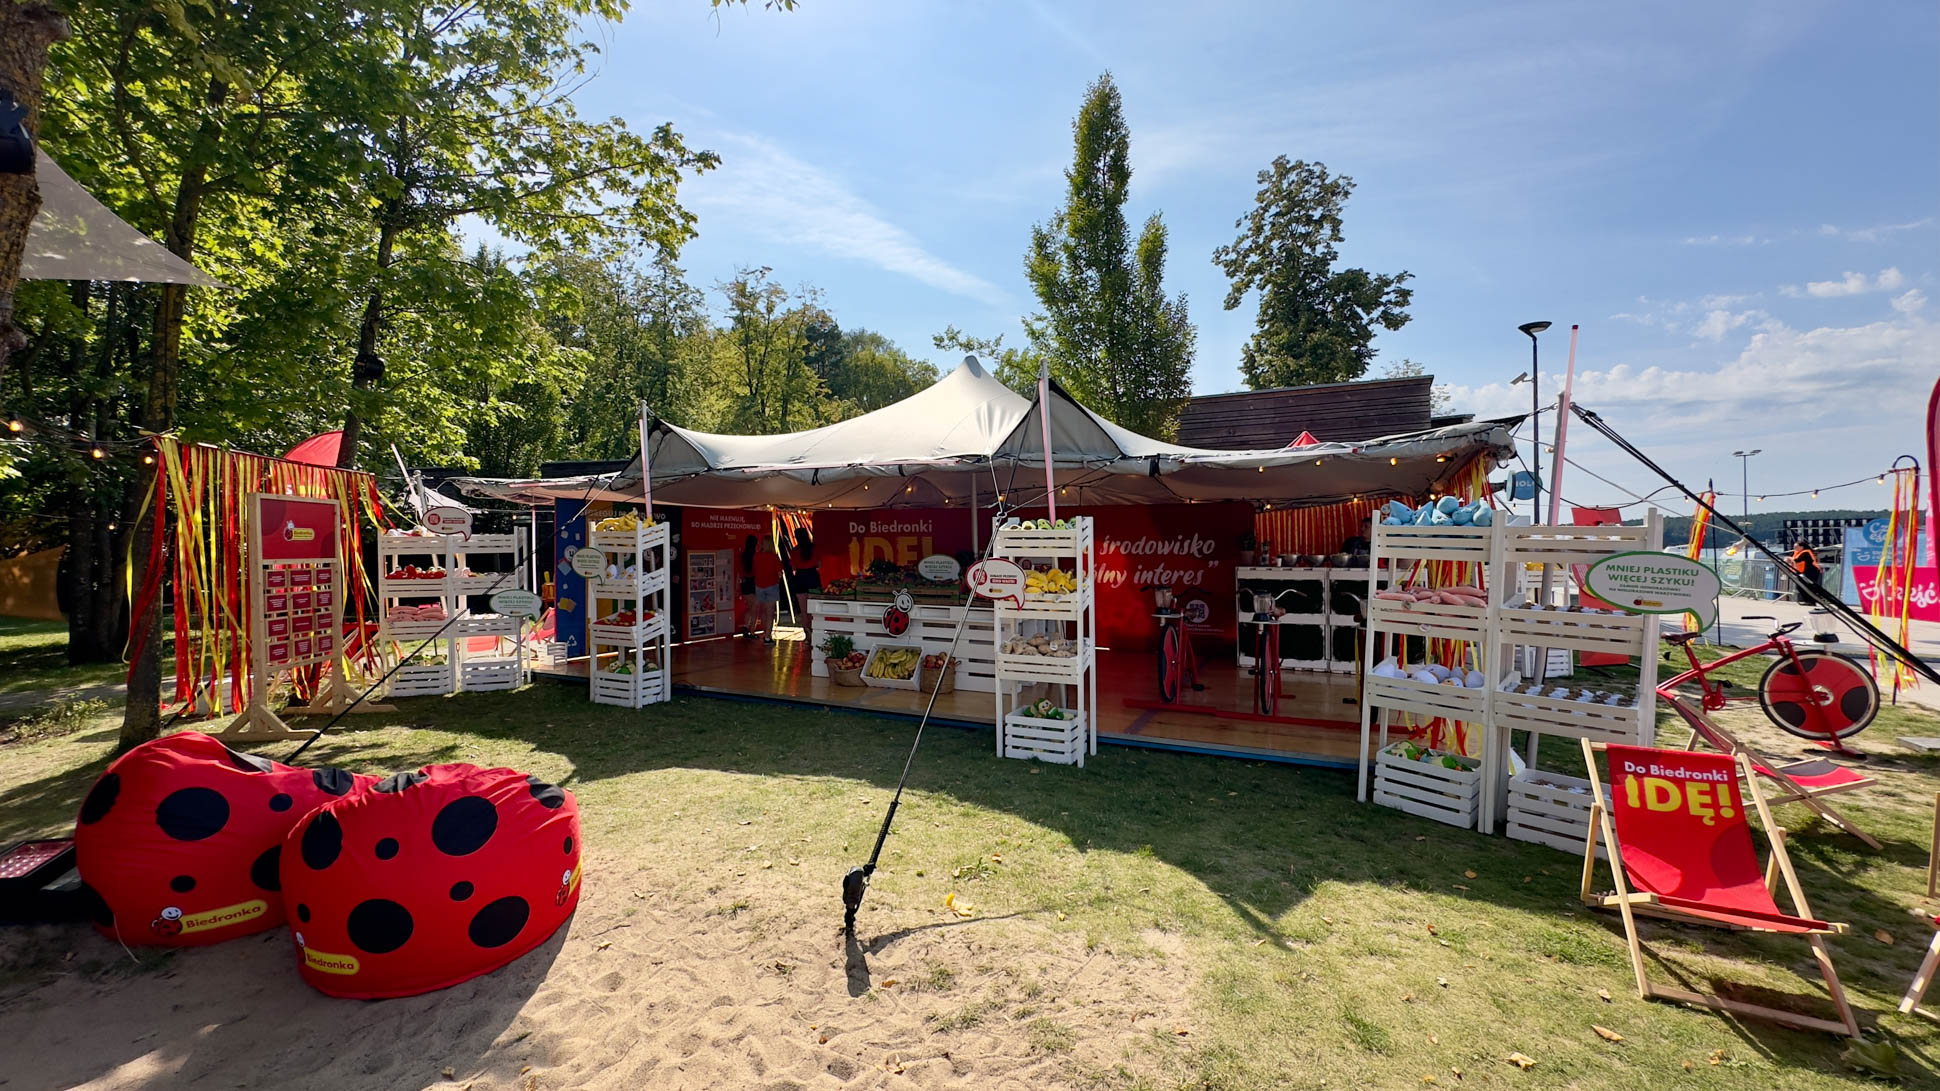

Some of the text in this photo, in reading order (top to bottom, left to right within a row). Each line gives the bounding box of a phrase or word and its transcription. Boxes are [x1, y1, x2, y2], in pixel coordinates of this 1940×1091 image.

[849, 519, 933, 533] Do Biedronki
[1099, 532, 1216, 558] środowisko
[1606, 564, 1699, 577] MNIEJ PLASTIKU
[1608, 574, 1695, 587] WIĘCEJ SZYKU!
[1624, 761, 1728, 781] Do Biedronki
[1624, 774, 1736, 827] IDĘ!
[186, 905, 261, 929] Biedronka
[306, 952, 355, 971] Biedronka
